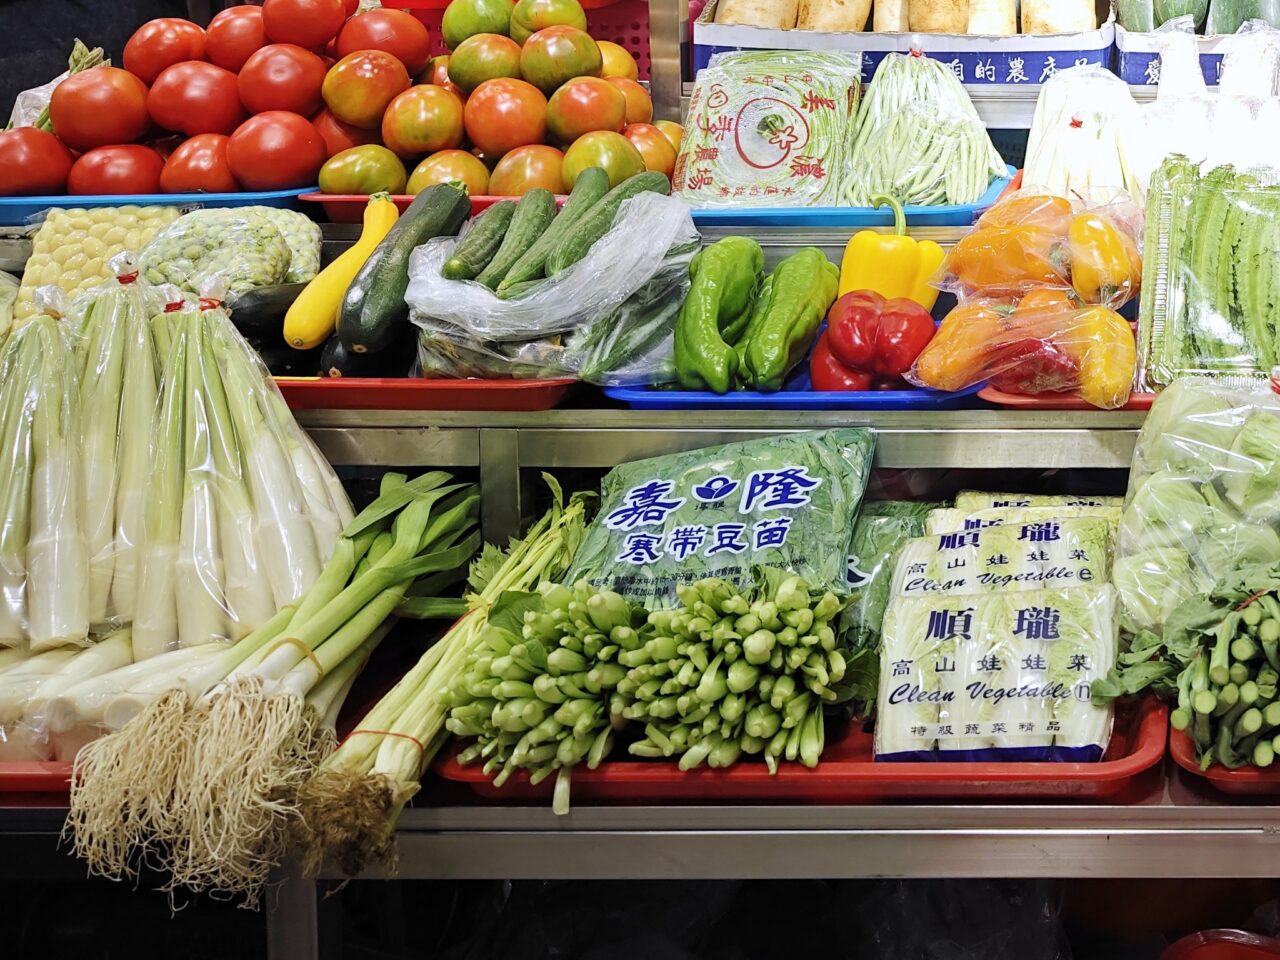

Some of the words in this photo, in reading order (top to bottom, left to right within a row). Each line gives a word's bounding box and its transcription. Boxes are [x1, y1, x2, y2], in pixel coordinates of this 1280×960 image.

[608, 481, 683, 527] 嘉
[744, 468, 818, 511] 隆
[619, 517, 791, 562] 寒帶豆苗
[906, 548, 1090, 575] 高山娃娃菜
[904, 577, 967, 592] Clean
[976, 567, 1075, 589] Vegetable
[891, 654, 1093, 677] 高山娃娃菜
[888, 683, 956, 704] Clean
[965, 681, 1072, 705] Vegetable
[910, 720, 1062, 736] 特級蔬菜精品
